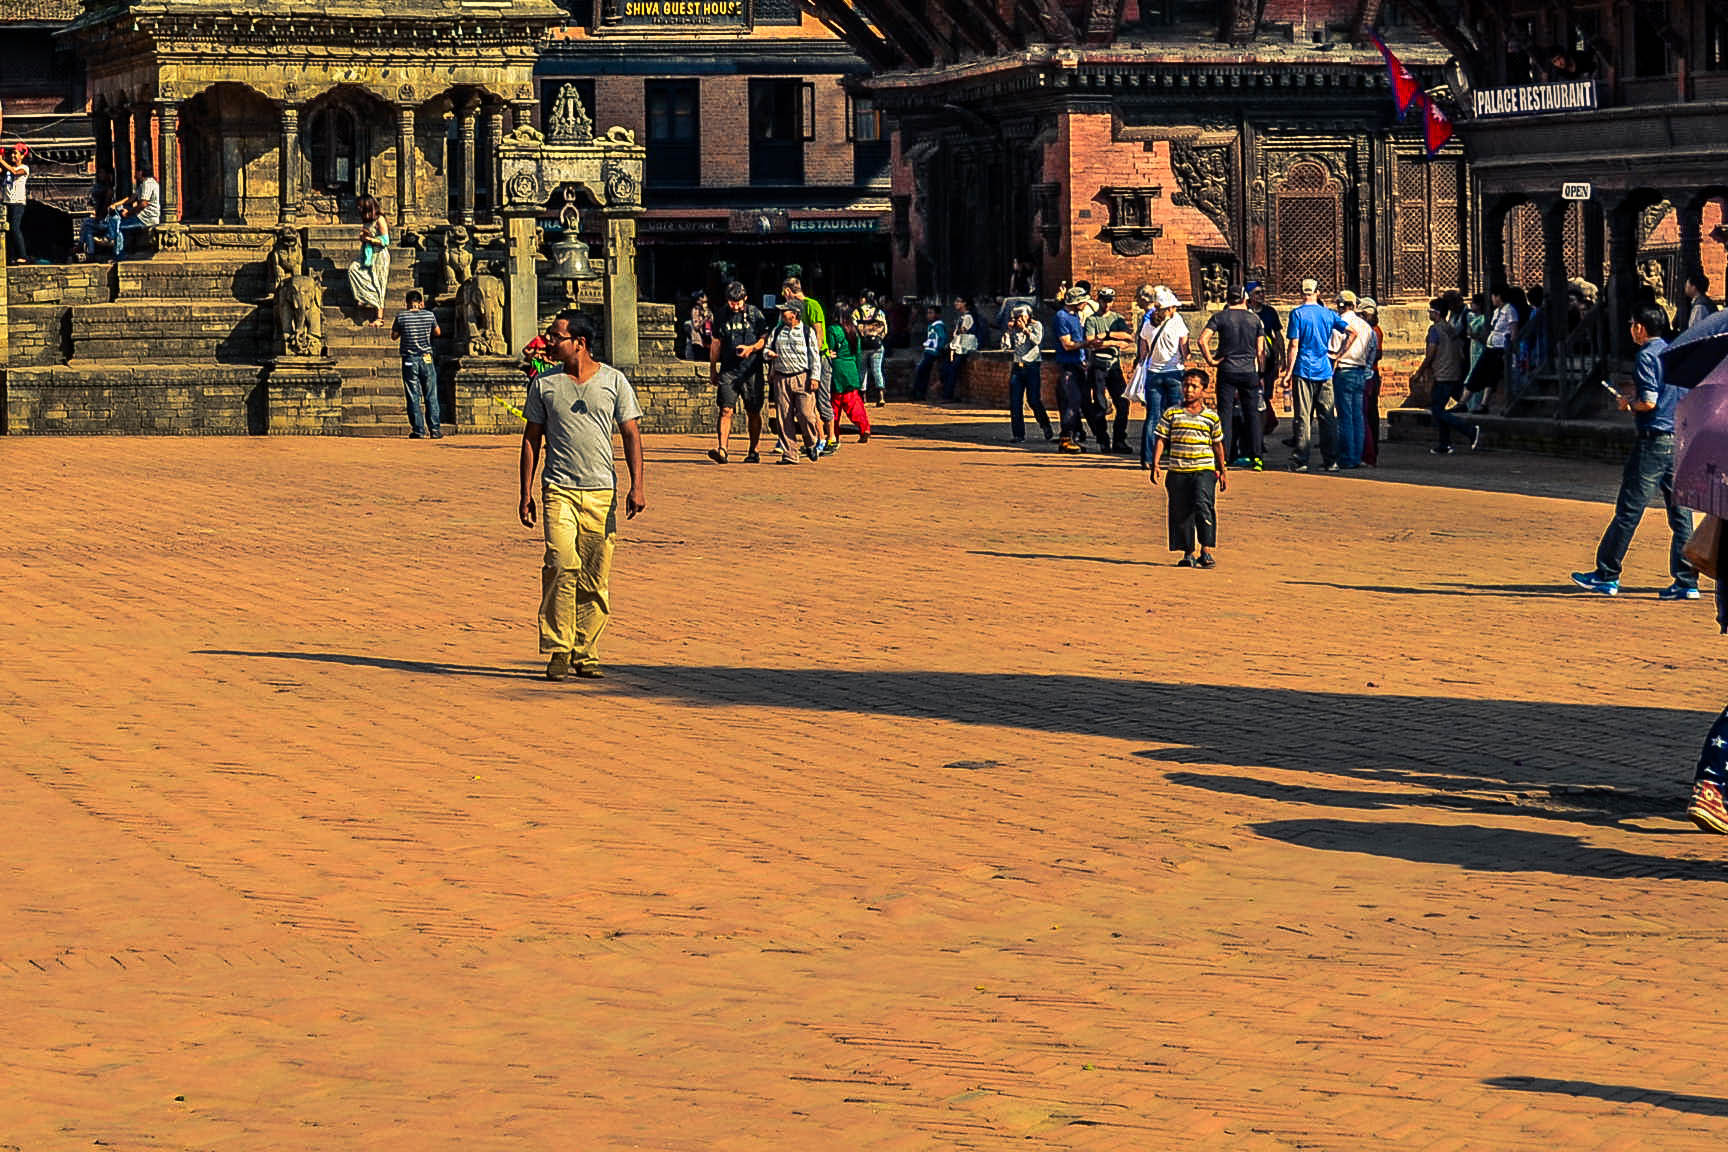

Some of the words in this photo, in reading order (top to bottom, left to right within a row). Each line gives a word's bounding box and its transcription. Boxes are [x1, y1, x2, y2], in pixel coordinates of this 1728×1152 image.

[625, 2, 660, 16] SHIVA
[663, 2, 701, 15] GUEST
[703, 1, 743, 15] HOUSE
[1477, 88, 1518, 115] PALACE
[1519, 81, 1592, 111] RESTAURANT
[1564, 185, 1589, 197] OPEN
[790, 219, 875, 230] RESTAURANT
